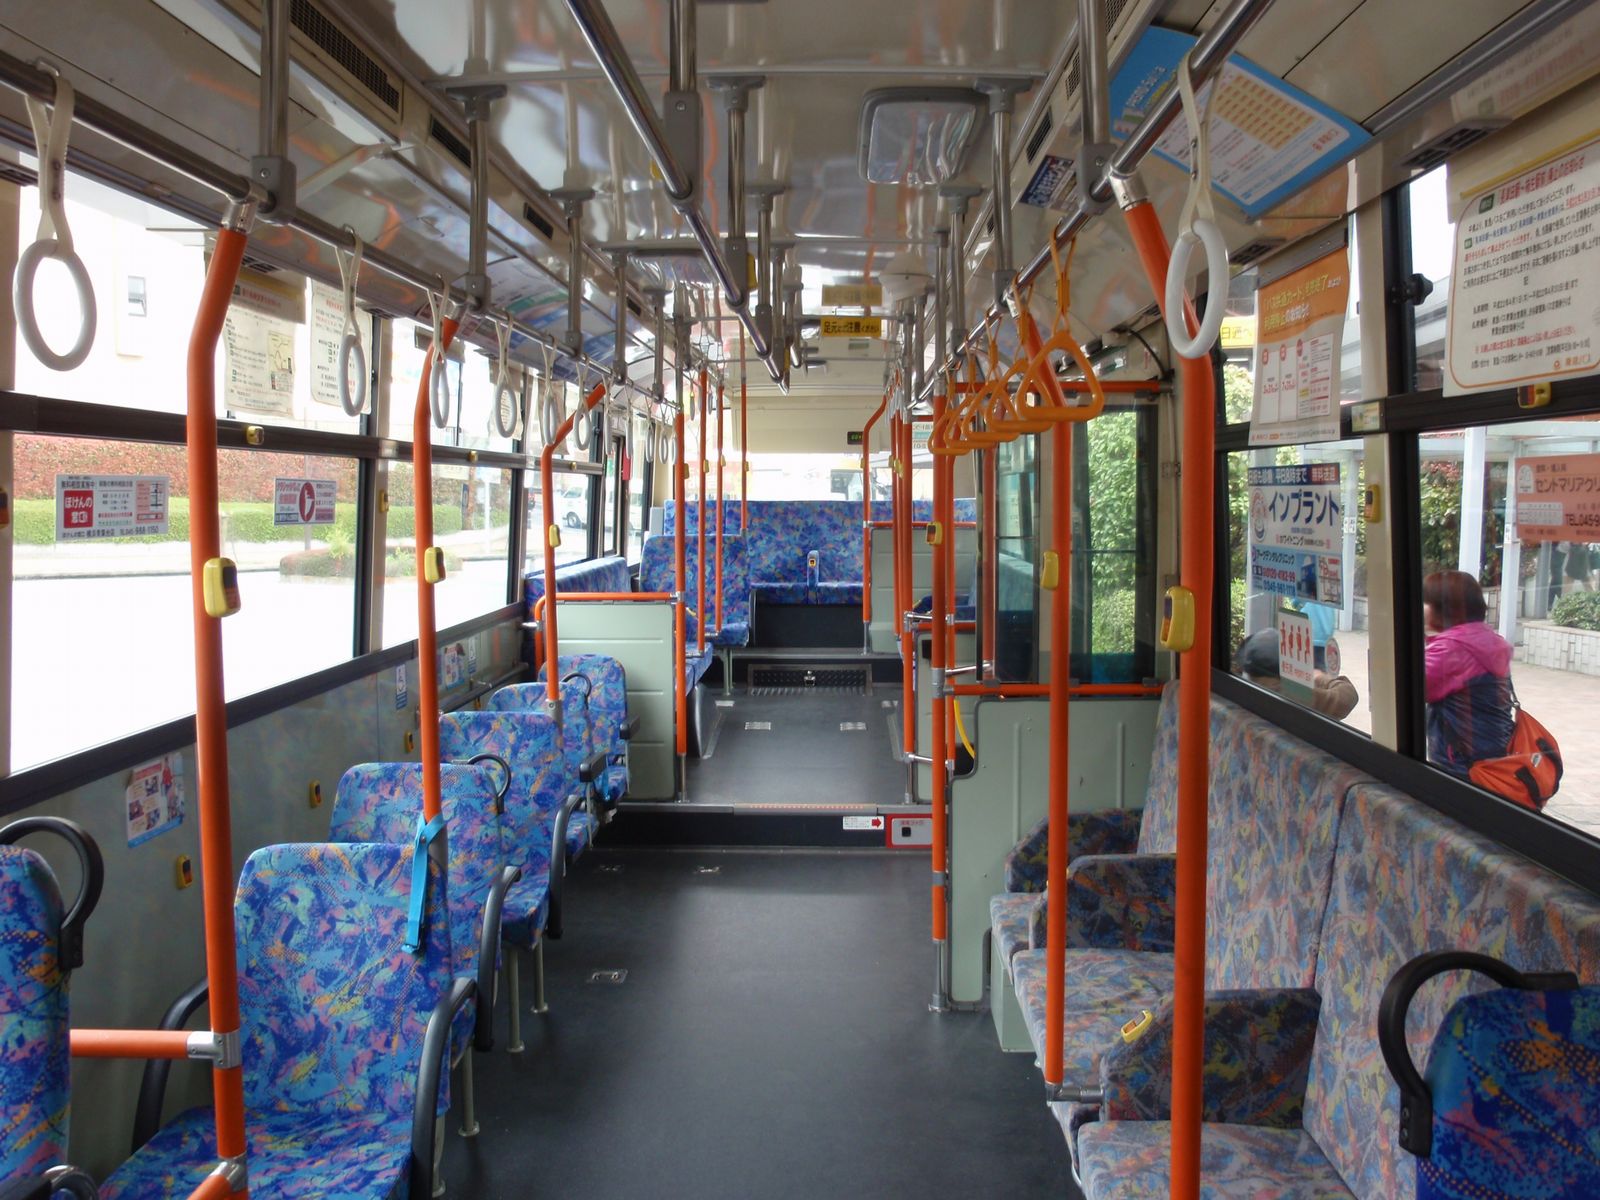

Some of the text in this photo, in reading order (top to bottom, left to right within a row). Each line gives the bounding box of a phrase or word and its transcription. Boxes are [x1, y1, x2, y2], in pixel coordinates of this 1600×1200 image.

[64, 497, 93, 509] ほけんの
[1268, 489, 1339, 527] インプラント
